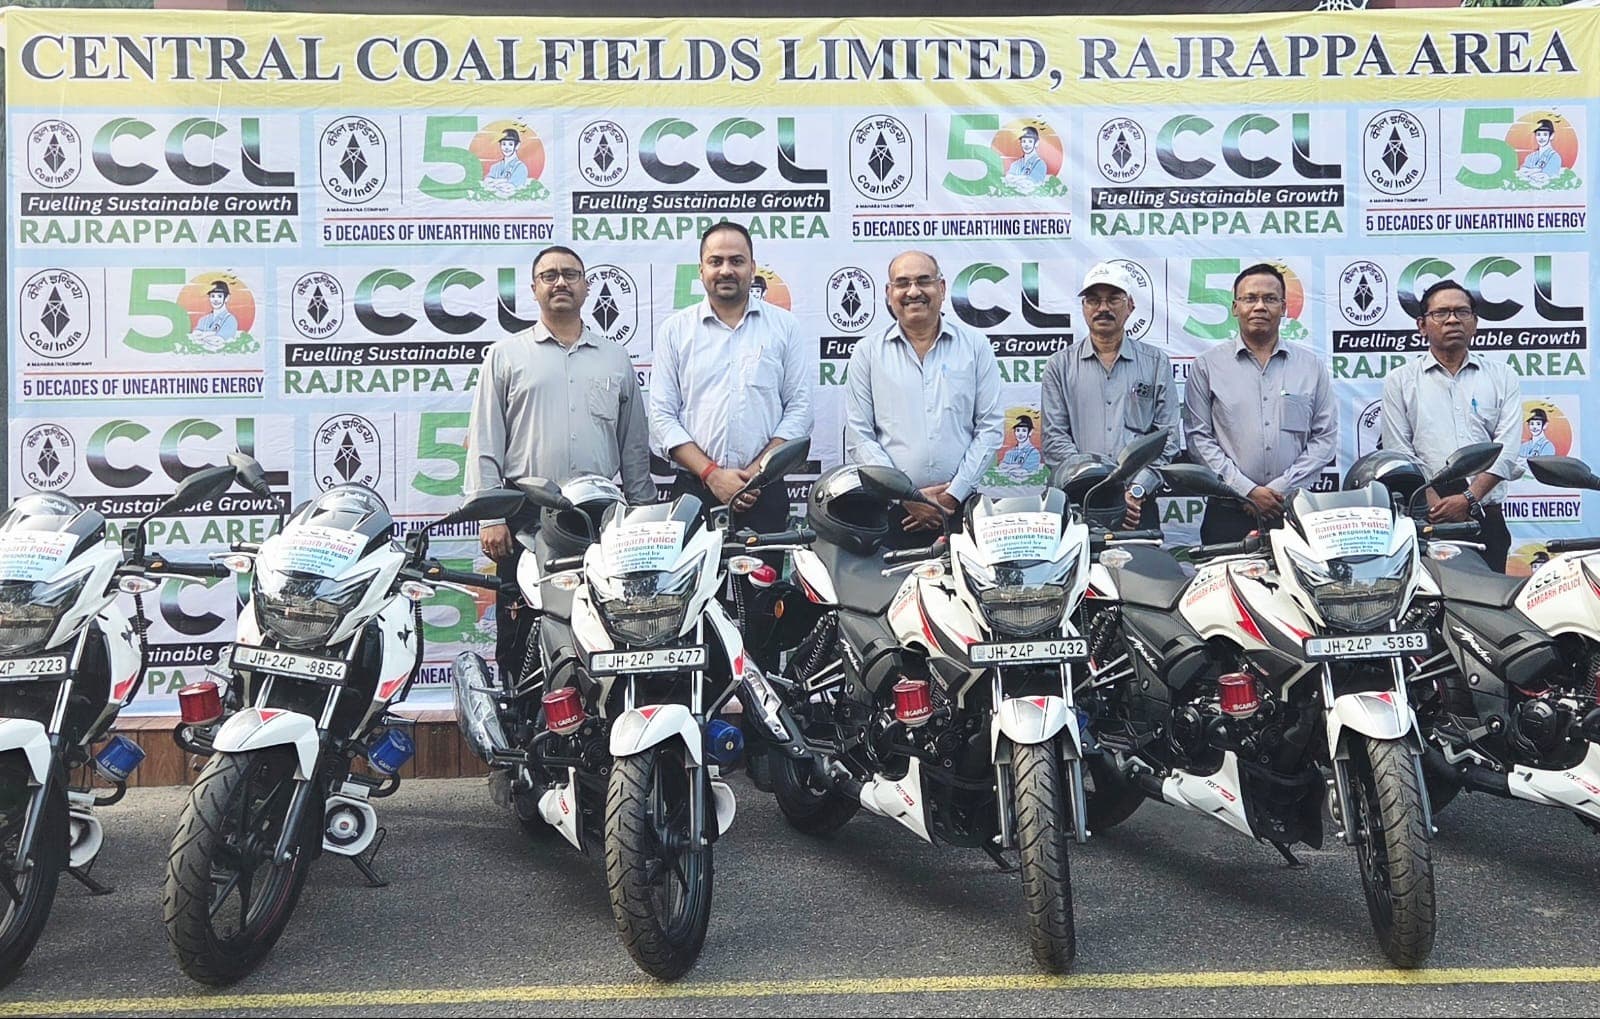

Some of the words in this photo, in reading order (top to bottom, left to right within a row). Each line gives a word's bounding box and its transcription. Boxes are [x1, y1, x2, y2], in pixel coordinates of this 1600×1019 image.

[22, 36, 340, 80] CENTRAL
[357, 38, 760, 81] COALFIELDS
[780, 39, 1061, 89] LIMITED,
[1080, 35, 1393, 79] RAJRAPPA
[1406, 31, 1577, 75] AREA
[327, 124, 347, 146] कोल
[856, 123, 874, 144] कोल
[1370, 118, 1388, 139] कोल
[92, 117, 295, 186] CCL
[638, 117, 828, 184] CCL
[1156, 113, 1341, 179] CCL
[34, 167, 53, 183] Coal
[55, 167, 75, 183] India
[585, 167, 602, 182] Coal
[604, 167, 623, 182] India
[1104, 164, 1120, 178] Coal
[1121, 164, 1140, 178] India
[1371, 169, 1393, 188] Coal
[1395, 169, 1419, 188] India
[329, 177, 352, 197] Coal
[354, 177, 379, 197] India
[857, 175, 879, 194] Coal
[881, 174, 905, 194] India
[28, 196, 103, 214] Fuelling
[107, 196, 219, 211] Sustainable
[225, 196, 291, 210] Growth
[579, 194, 648, 212] Fuelling
[652, 194, 755, 208] Sustainable
[762, 193, 824, 207] Growth
[1098, 191, 1165, 208] Fuelling
[1169, 189, 1271, 204] Sustainable
[1277, 188, 1338, 202] Growth
[749, 216, 829, 240] AREA
[853, 222, 860, 236] 5
[864, 221, 919, 236] DECADES
[924, 221, 938, 235] OF
[942, 220, 1020, 235] UNEARTHING
[1024, 219, 1071, 234] ENERGY
[1091, 212, 1250, 235] RAJRAPPA
[1260, 211, 1342, 233] AREA
[1367, 216, 1373, 230] 5
[1378, 215, 1433, 230] DECADES
[1437, 215, 1451, 229] OF
[1456, 213, 1533, 229] UNEARTHING
[1538, 212, 1585, 228] ENERGY
[21, 220, 196, 246] RAJRAPPA
[208, 220, 297, 242] AREA
[324, 226, 331, 240] 5
[336, 225, 394, 240] DECADES
[399, 225, 414, 240] OF
[419, 224, 499, 240] UNEARTHING
[504, 224, 553, 239] ENERGY
[27, 277, 48, 300] कोल
[886, 263, 1070, 328] CL
[1396, 256, 1583, 321] CCL
[353, 268, 537, 335] CCL
[833, 312, 850, 328] Coal
[851, 312, 870, 328] India
[1345, 306, 1362, 321] Coal
[1364, 306, 1382, 321] India
[298, 318, 316, 334] Coal
[318, 318, 337, 334] India
[605, 324, 630, 343] ndia
[1125, 318, 1146, 337] ndia
[29, 331, 53, 351] Coal
[55, 331, 82, 351] India
[1006, 337, 1069, 356] Growth
[1339, 334, 1407, 350] Fuelling
[1518, 330, 1581, 350] Growth
[292, 347, 364, 364] Fuelling
[368, 345, 475, 360] Sustainable
[285, 369, 453, 393] RAJRAPPA
[998, 360, 1046, 382] ARE
[24, 380, 31, 395] 5
[37, 380, 98, 395] DECADES
[103, 379, 118, 395] OF
[123, 378, 208, 394] UNEARTHING
[213, 377, 263, 393] ENERGY
[321, 422, 341, 444] कोल
[28, 472, 46, 487] Coal
[48, 471, 69, 487] India
[219, 497, 284, 511] Growth
[1532, 502, 1580, 517] ENERGY
